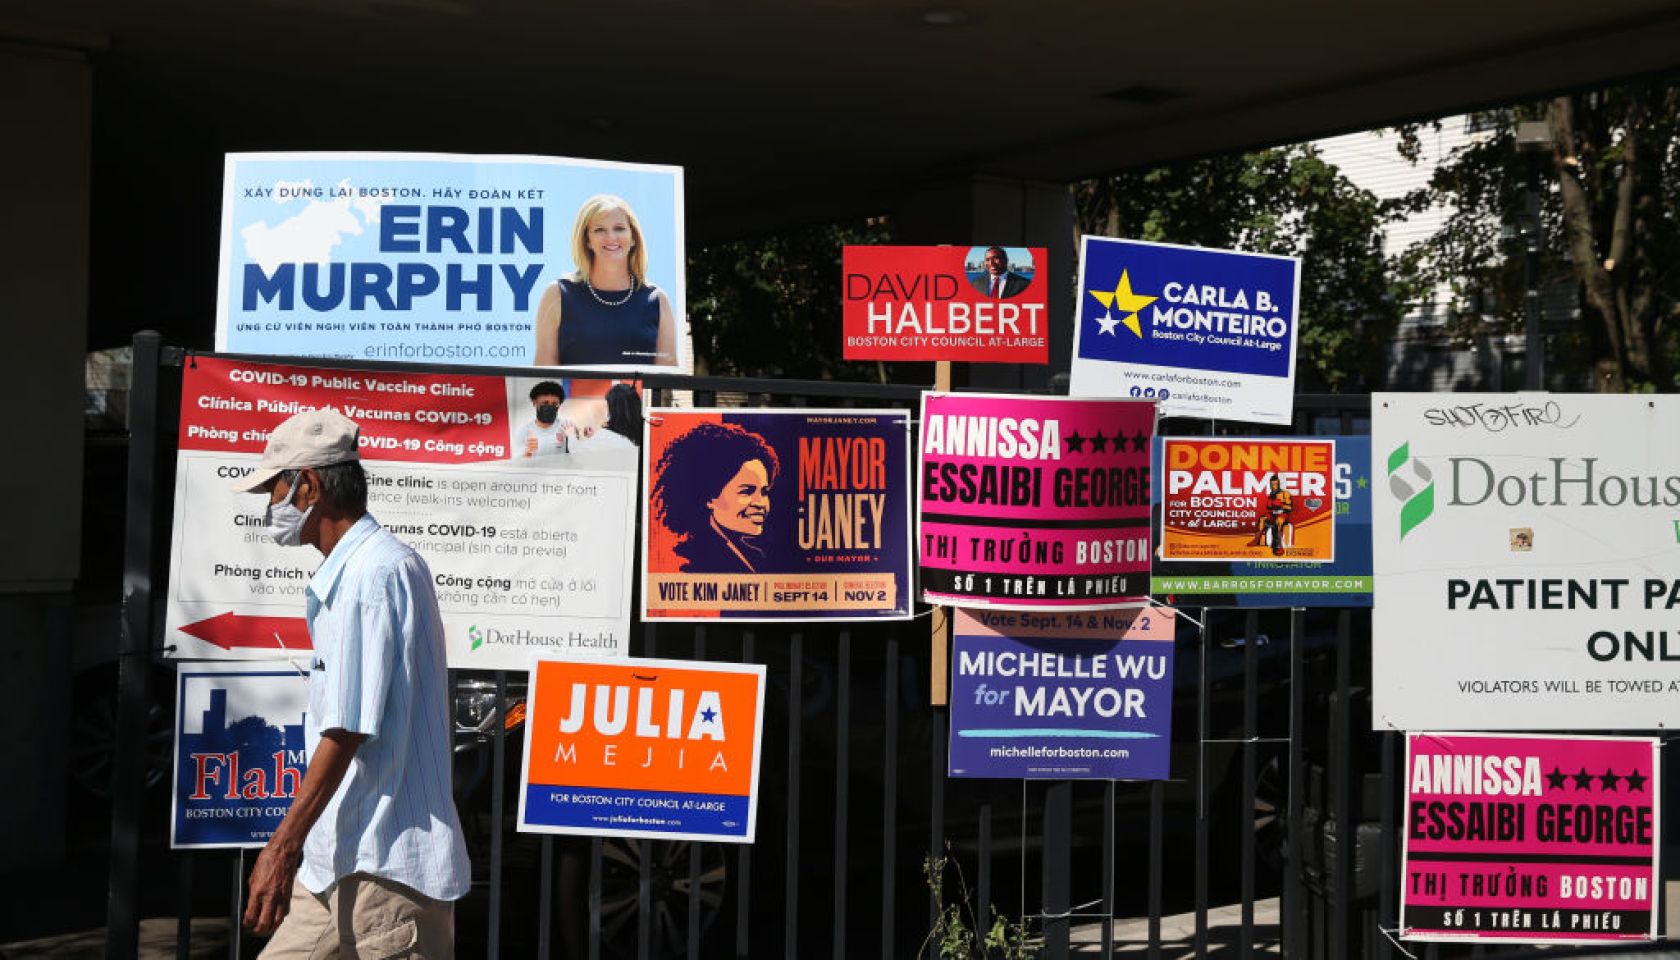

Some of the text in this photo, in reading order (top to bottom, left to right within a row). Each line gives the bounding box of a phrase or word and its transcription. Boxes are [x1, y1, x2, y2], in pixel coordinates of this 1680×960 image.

[359, 188, 426, 198] BOSTON.
[380, 204, 544, 254] ERIN
[242, 263, 544, 312] MURPHY
[847, 273, 959, 301] DAVID
[1163, 281, 1279, 313] CARLA B.
[486, 322, 531, 331] BOSTON
[867, 301, 1045, 335] HALBERT
[1152, 304, 1287, 339] MONTEIRO
[363, 342, 526, 358] erinforboston.com
[847, 336, 1045, 347] BOSTON CITY COUNCIL AT-LARGE
[1152, 329, 1282, 351] Boston City Council At-Large
[229, 368, 475, 398] COVID-19 Public Vaccine Clinic
[1123, 370, 1242, 388] www.carlaforboston.com
[198, 394, 252, 411] Clínica
[344, 405, 411, 421] Vacunas
[415, 409, 493, 425] COVID-19
[187, 424, 239, 443] Phòng
[358, 435, 421, 451] OVID-19
[424, 439, 465, 455] Công
[468, 440, 505, 457] cộng
[925, 414, 1061, 461] ANNISSA
[799, 436, 886, 500] MAYOR
[1169, 444, 1328, 471] DONNIE
[396, 475, 434, 489] clinic
[438, 480, 448, 490] is
[451, 480, 486, 493] open
[490, 480, 537, 494] around
[542, 480, 563, 495] the
[567, 482, 597, 497] front
[924, 461, 1150, 508] ESSAIBI GEORGE
[1169, 470, 1326, 497] PALMER
[1447, 456, 1680, 507] DotHous
[1169, 510, 1256, 518] CITY COUNCILOR
[1190, 496, 1257, 508] BOSTON
[428, 523, 496, 538] COVID-19
[532, 528, 578, 542] abierta
[799, 493, 886, 549] JANEY
[1203, 520, 1238, 528] LARGE
[495, 541, 518, 556] cita
[925, 532, 1148, 565] THỊ TRƯỞNG BOSTON
[658, 581, 760, 603] VOTE KIM JANEY
[773, 590, 829, 603] SEPT 14
[844, 590, 887, 602] NOV 2
[985, 578, 992, 593] 1
[1003, 575, 1046, 595] TRÊN
[1058, 576, 1075, 595] LÁ
[1162, 579, 1364, 590] WWW.BARROSFORMAYOR.COM
[1448, 578, 1630, 610] PATIENT
[980, 612, 1151, 631] Vote Sept. 14 & Nov. 2
[486, 627, 618, 648] DotHouse Health
[1587, 630, 1680, 662] ONL
[959, 650, 1167, 680] MICHELLE WU
[1458, 680, 1539, 693] VIOLATORS
[1544, 680, 1580, 693] WILL
[1586, 680, 1602, 693] BE
[1607, 680, 1662, 693] TOWED
[559, 682, 726, 742] JULIA
[974, 683, 1147, 718] for MAYOR
[554, 741, 728, 773] MEJIA
[990, 745, 1129, 759] michelleforboston.com
[1411, 754, 1543, 796] ANNISSA
[186, 808, 234, 818] BOSTON
[236, 807, 263, 818] CITY
[550, 793, 726, 811] FOR BOSTON CITY COUNCIL AT-LARGE
[1411, 801, 1653, 845] ESSAIBI GEORGE
[1411, 865, 1648, 901] THỊ TRƯỞNG BOSTON
[1474, 912, 1481, 927] 1
[1491, 909, 1532, 928] TRÊN
[1542, 910, 1561, 929] LÁ
